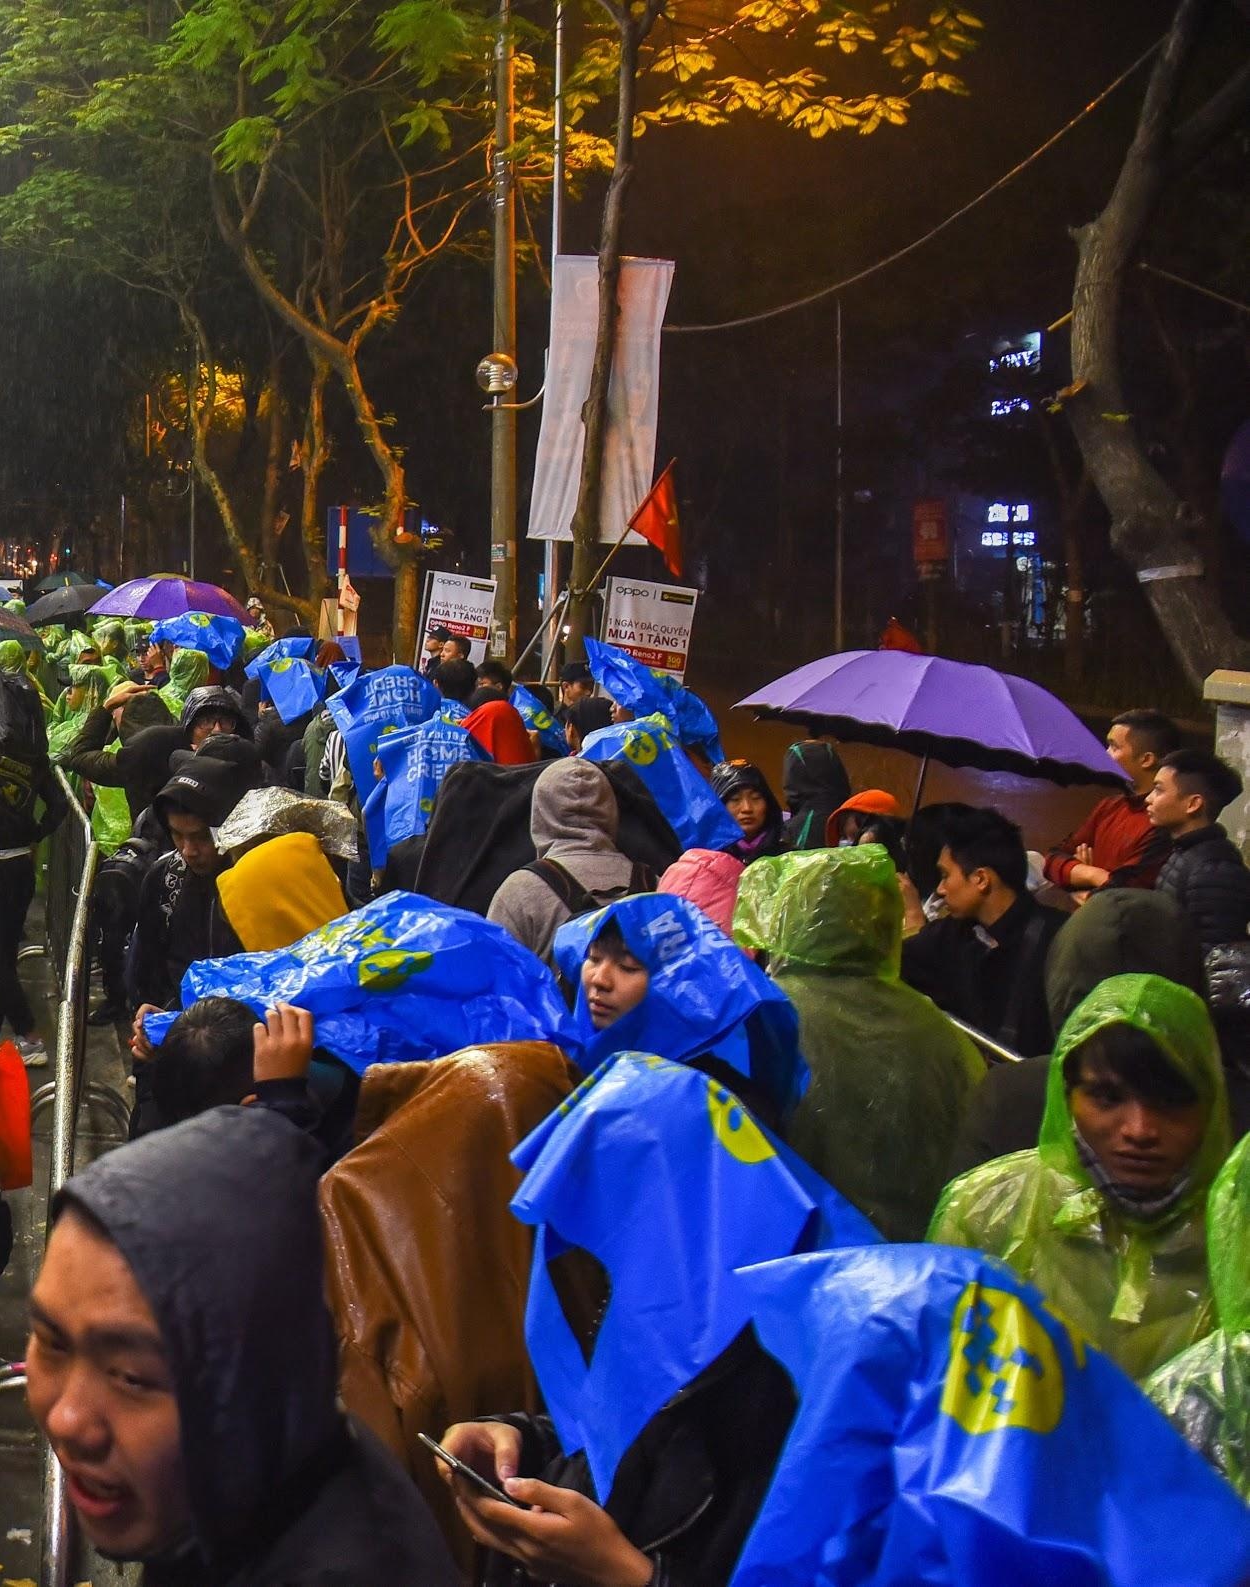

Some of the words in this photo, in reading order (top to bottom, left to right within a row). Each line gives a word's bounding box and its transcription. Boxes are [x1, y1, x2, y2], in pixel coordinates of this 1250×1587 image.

[431, 608, 450, 617] MUA
[458, 611, 483, 623] TẶNG
[608, 628, 636, 641] MUA
[639, 633, 644, 643] 1
[647, 632, 679, 647] TẶNG
[681, 639, 686, 649] 1
[632, 648, 657, 660] Reno2
[369, 688, 421, 707] HOME
[407, 744, 471, 767] HOME
